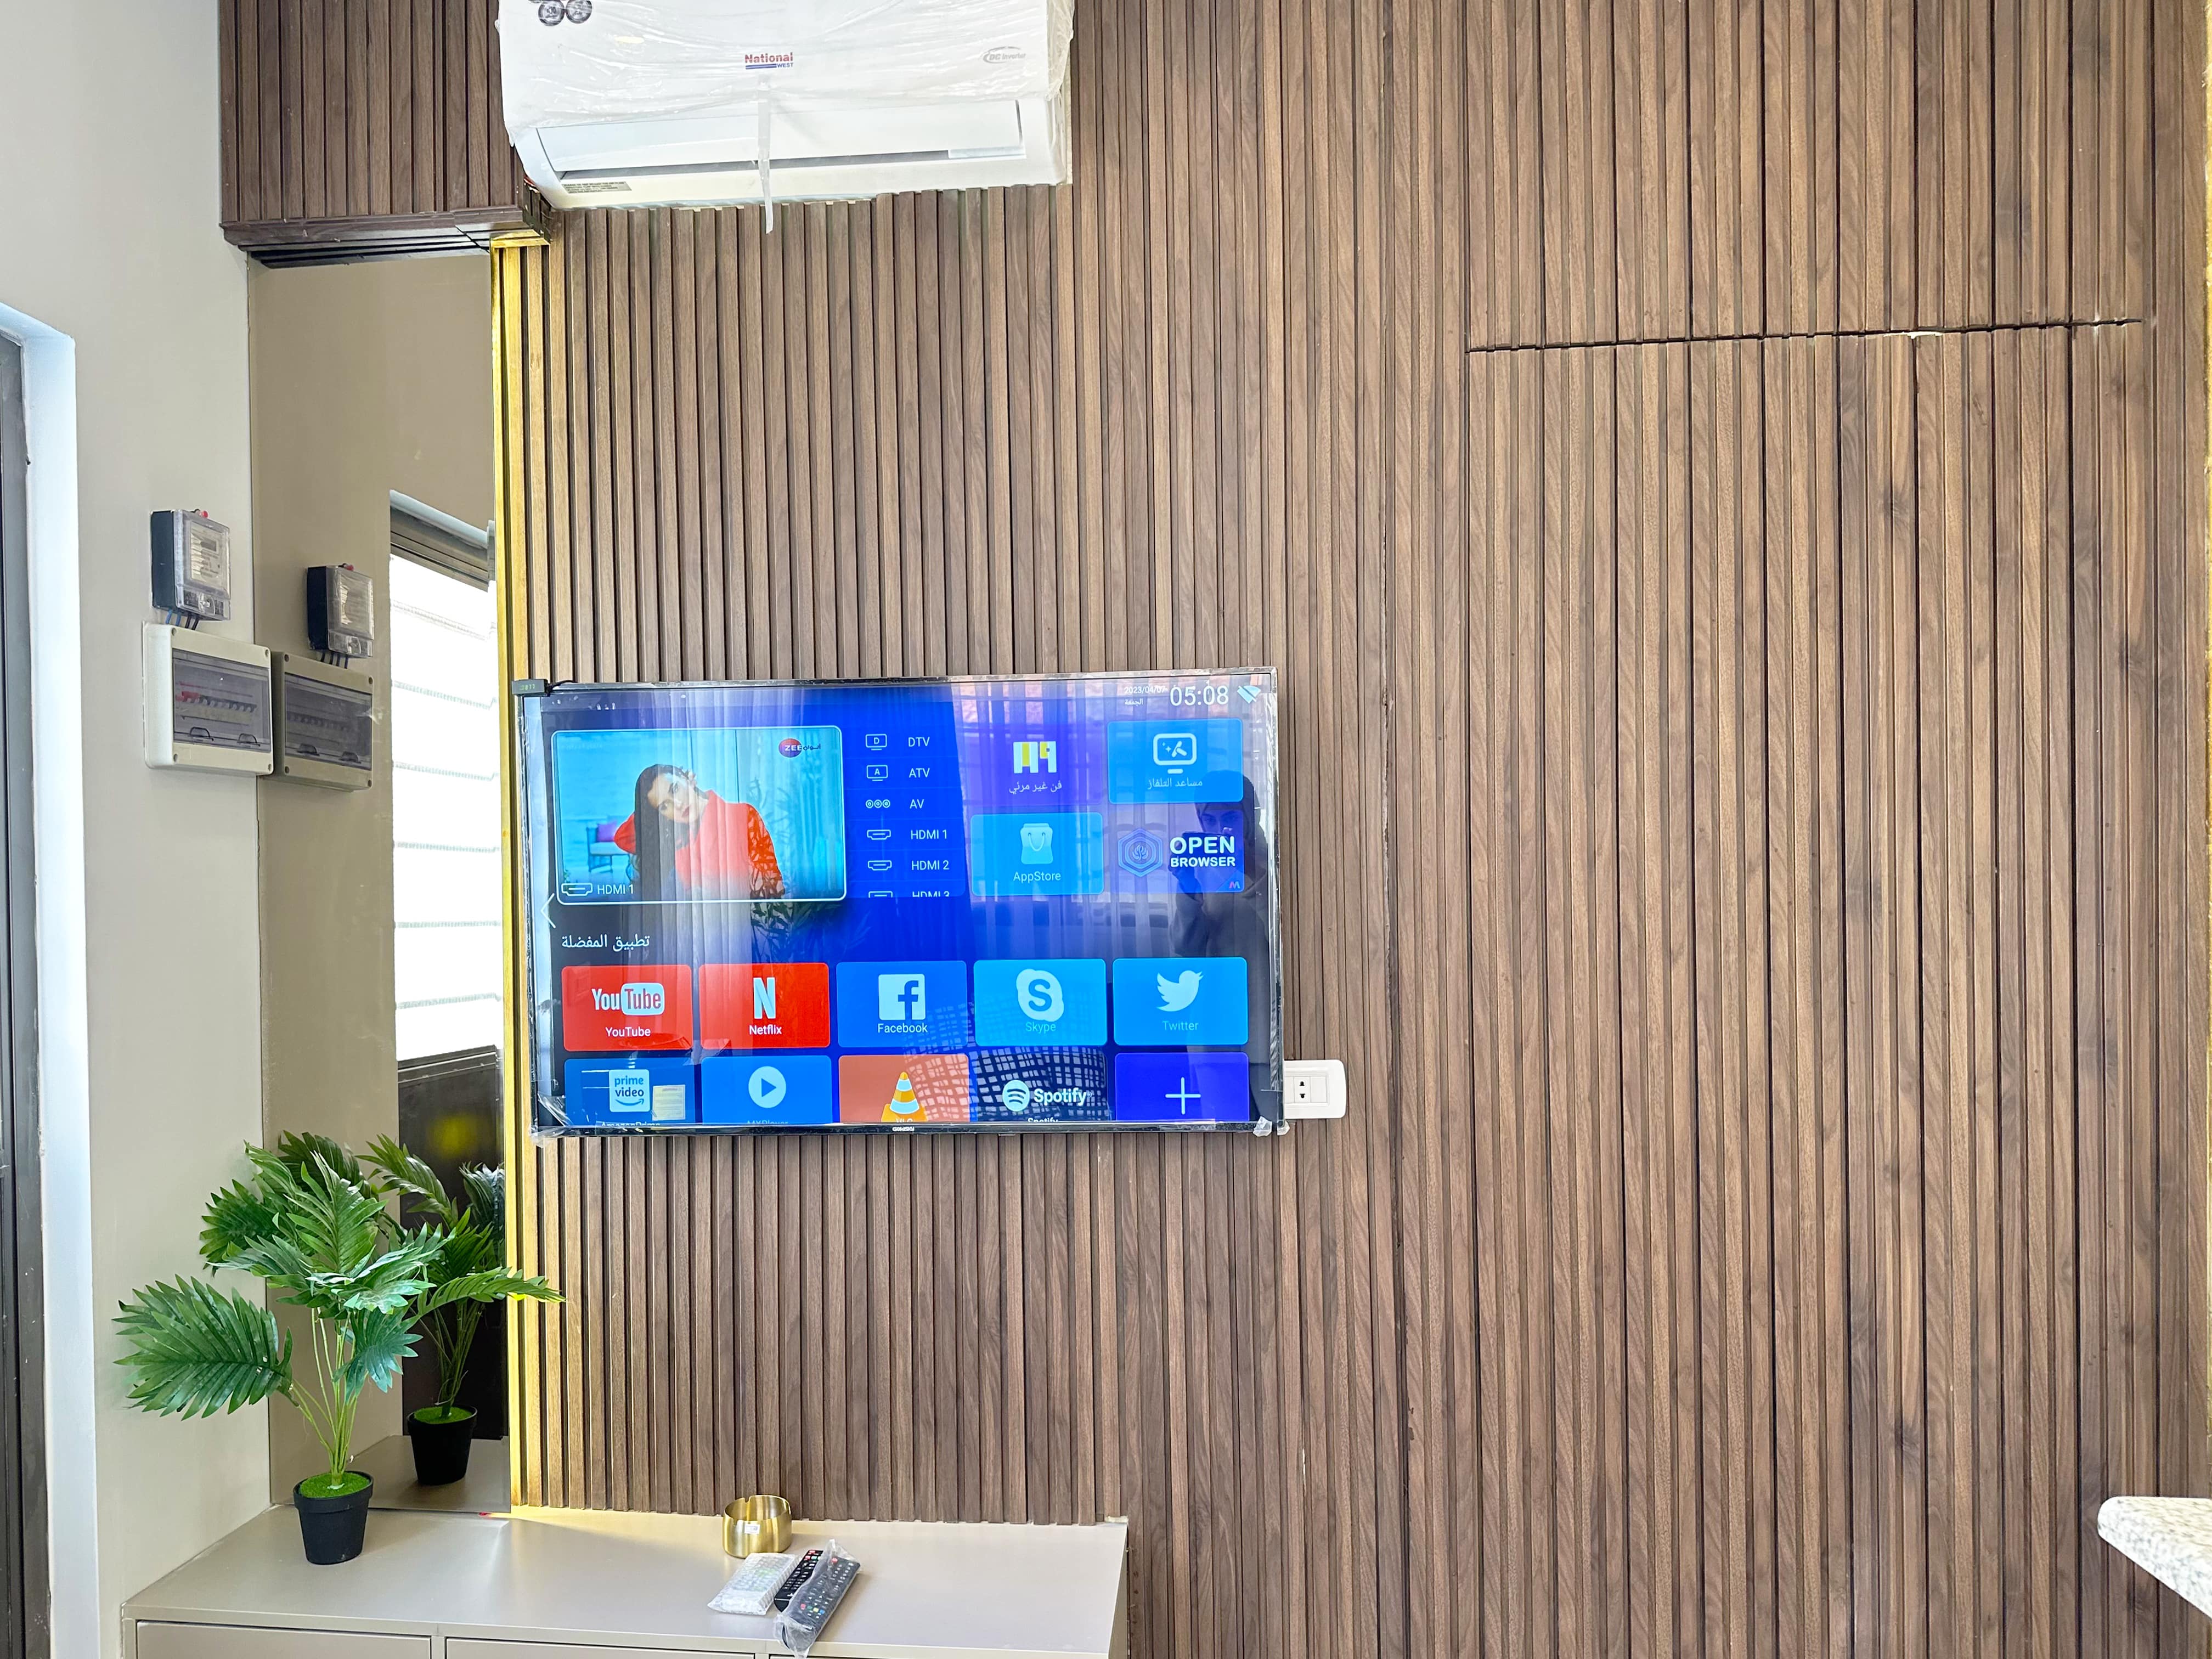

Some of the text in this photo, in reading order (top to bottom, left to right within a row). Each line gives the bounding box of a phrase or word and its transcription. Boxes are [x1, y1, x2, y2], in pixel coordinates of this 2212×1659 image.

[745, 52, 793, 63] National
[1170, 685, 1229, 706] 05:08
[908, 737, 930, 747] DTV
[909, 768, 930, 778] ATV
[1032, 781, 1048, 792] غير
[1050, 780, 1062, 792] فن
[1147, 777, 1203, 789] مساعد التلفاز
[909, 799, 924, 809] AV
[911, 829, 947, 839] HDMI 1
[1170, 836, 1234, 854] OPEN
[911, 860, 950, 870] HDMI 2
[1170, 857, 1235, 867] BROWSER
[1013, 871, 1061, 884] AppStore
[597, 884, 634, 894] HDMI 1
[561, 934, 650, 952] تطبيق المفضلة
[591, 988, 662, 1011] YouTube
[753, 977, 776, 1019] N
[749, 1024, 782, 1035] Netflix
[878, 1023, 928, 1033] Facebook
[1025, 1021, 1056, 1034] Skype
[1162, 1020, 1199, 1030] Twitter
[606, 1026, 651, 1037] YouTube
[614, 1075, 644, 1087] prime
[614, 1087, 644, 1097] video
[1034, 1087, 1087, 1107] Spotify
